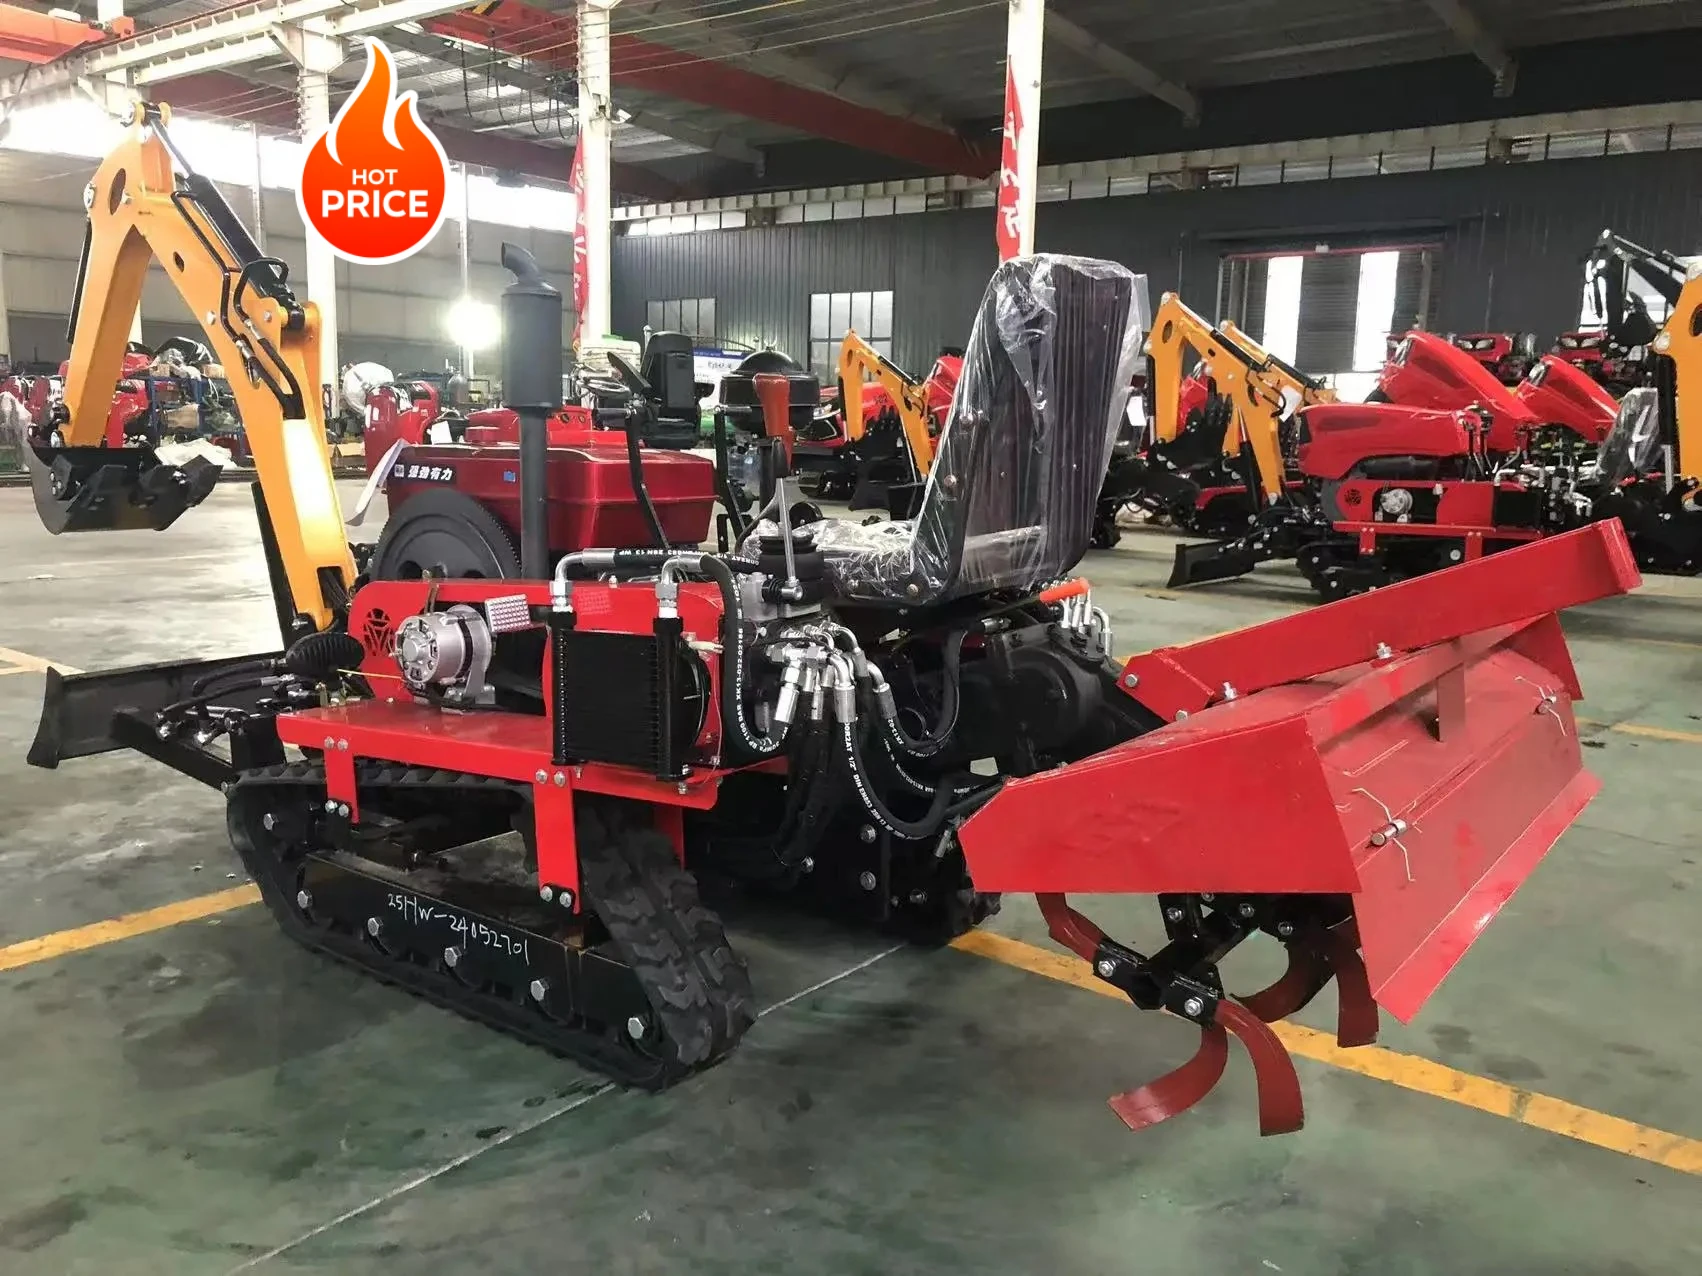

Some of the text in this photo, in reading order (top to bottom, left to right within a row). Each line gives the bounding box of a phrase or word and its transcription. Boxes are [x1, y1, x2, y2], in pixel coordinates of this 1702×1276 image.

[408, 464, 453, 480] 强劲有力
[853, 773, 863, 788] DIN
